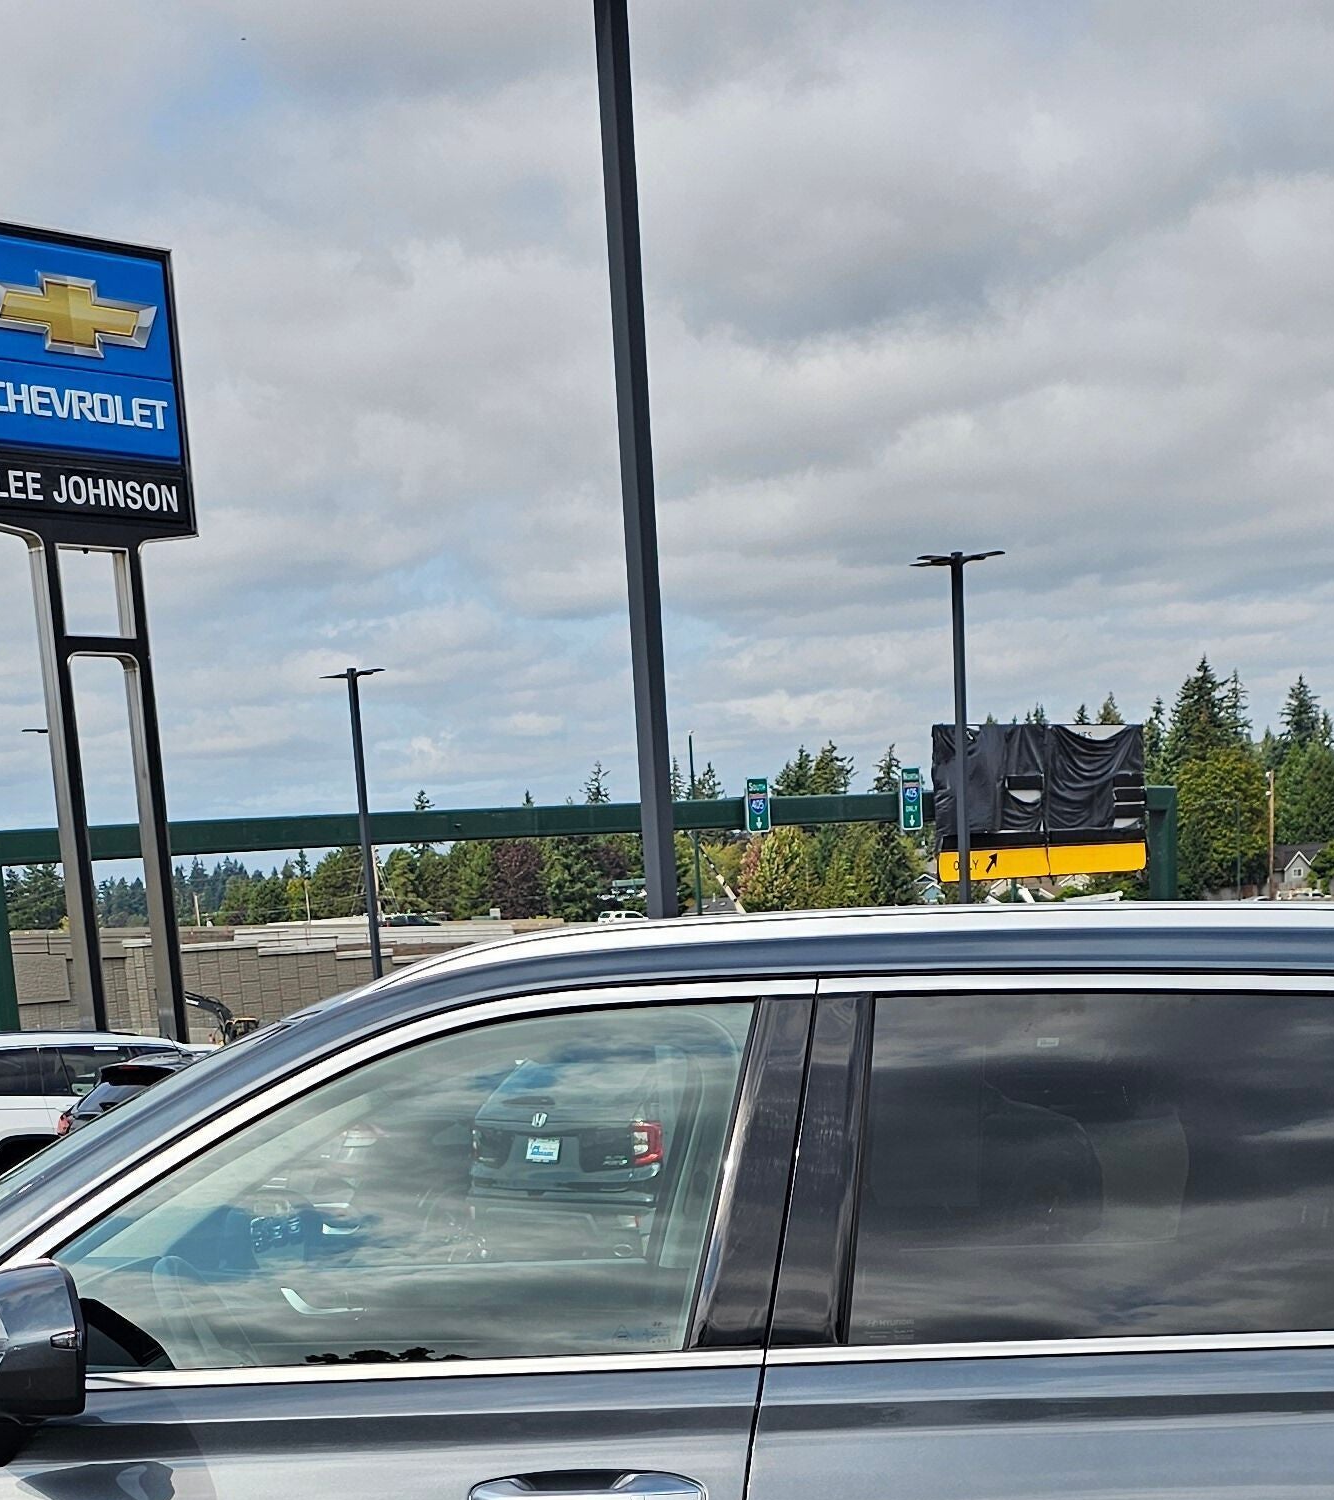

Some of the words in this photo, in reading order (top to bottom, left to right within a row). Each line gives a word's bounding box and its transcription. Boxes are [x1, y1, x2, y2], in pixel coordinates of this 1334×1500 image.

[53, 474, 179, 513] JOHNSON
[906, 787, 917, 798] 405
[751, 799, 765, 810] 405
[953, 859, 979, 871] OY
